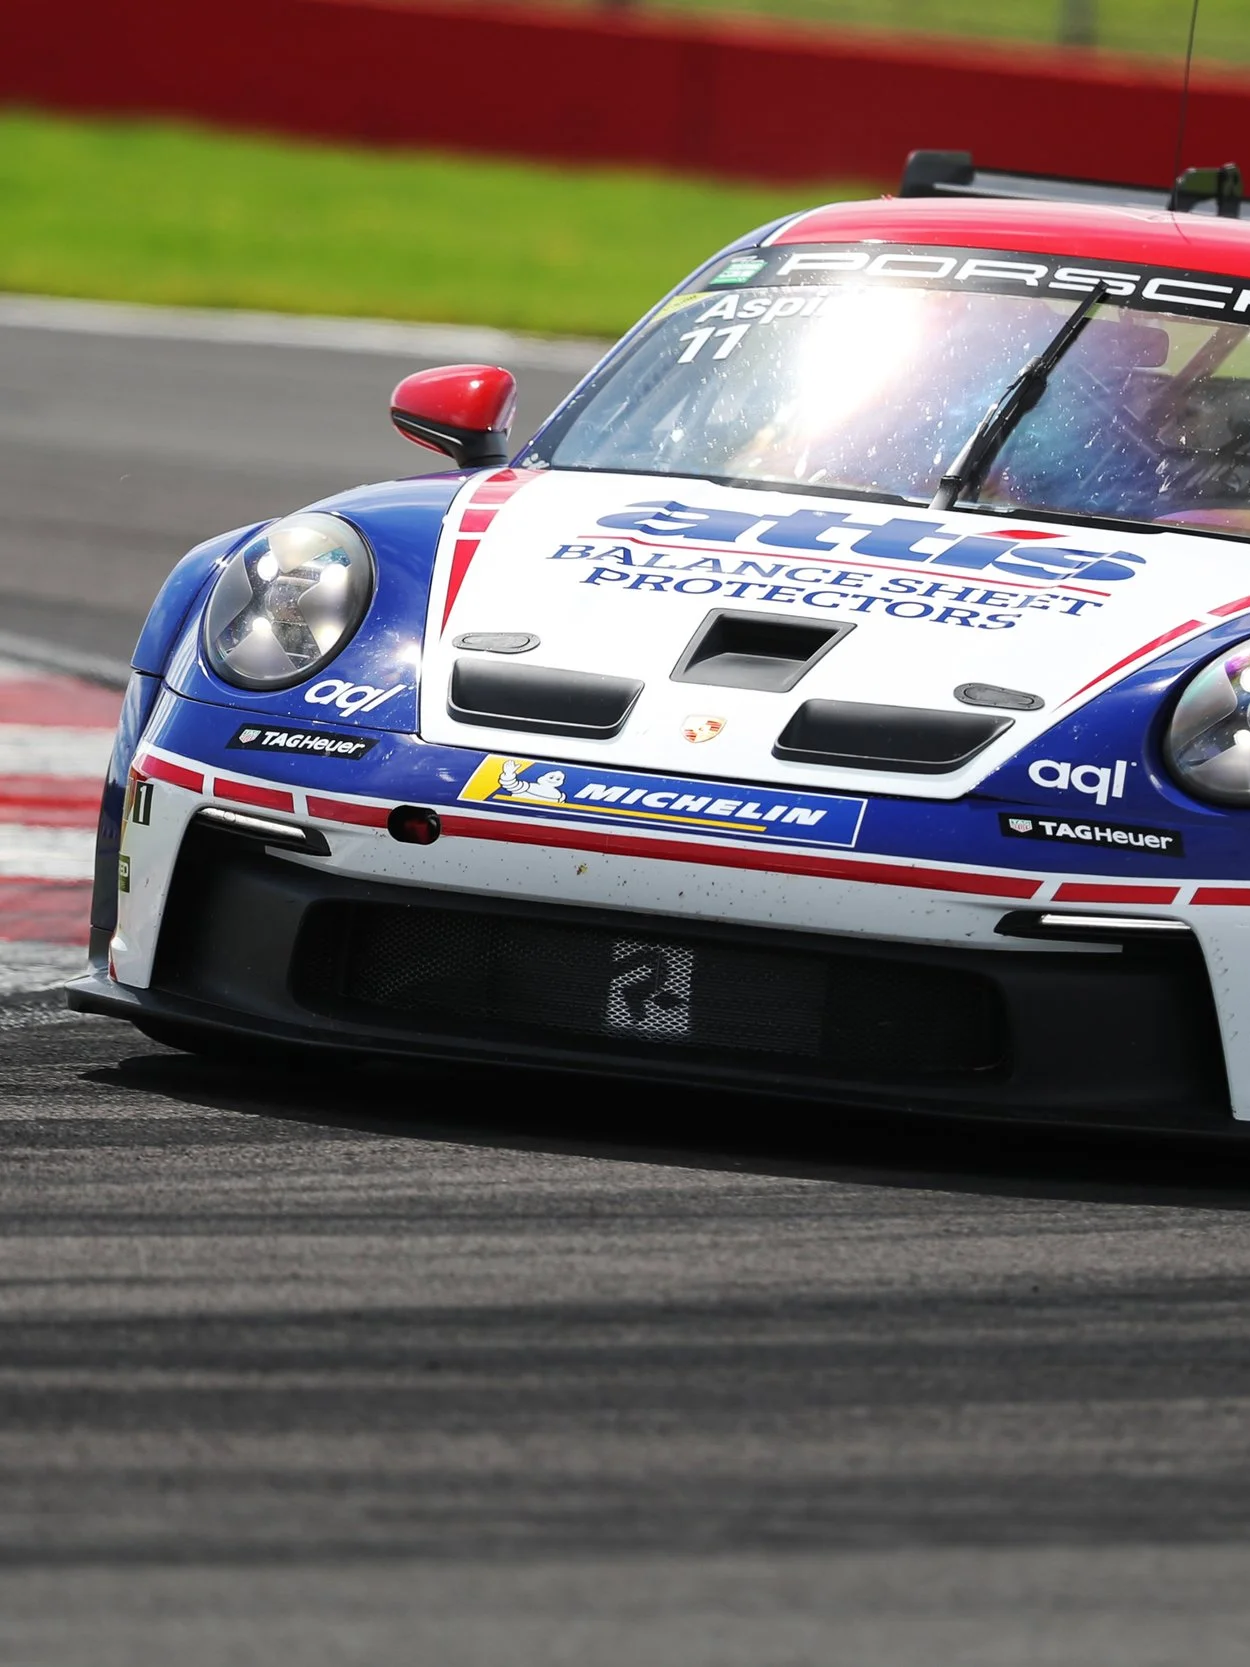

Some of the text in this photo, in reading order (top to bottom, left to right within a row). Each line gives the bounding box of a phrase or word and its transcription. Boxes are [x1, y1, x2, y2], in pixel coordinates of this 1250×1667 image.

[677, 323, 751, 364] 11
[596, 500, 1147, 581] attis
[546, 544, 1103, 616] BALANCE SHEET
[580, 566, 1022, 630] PROTECTORS
[304, 679, 407, 718] aql
[574, 782, 828, 827] MICHELIN
[1028, 759, 1128, 806] aql
